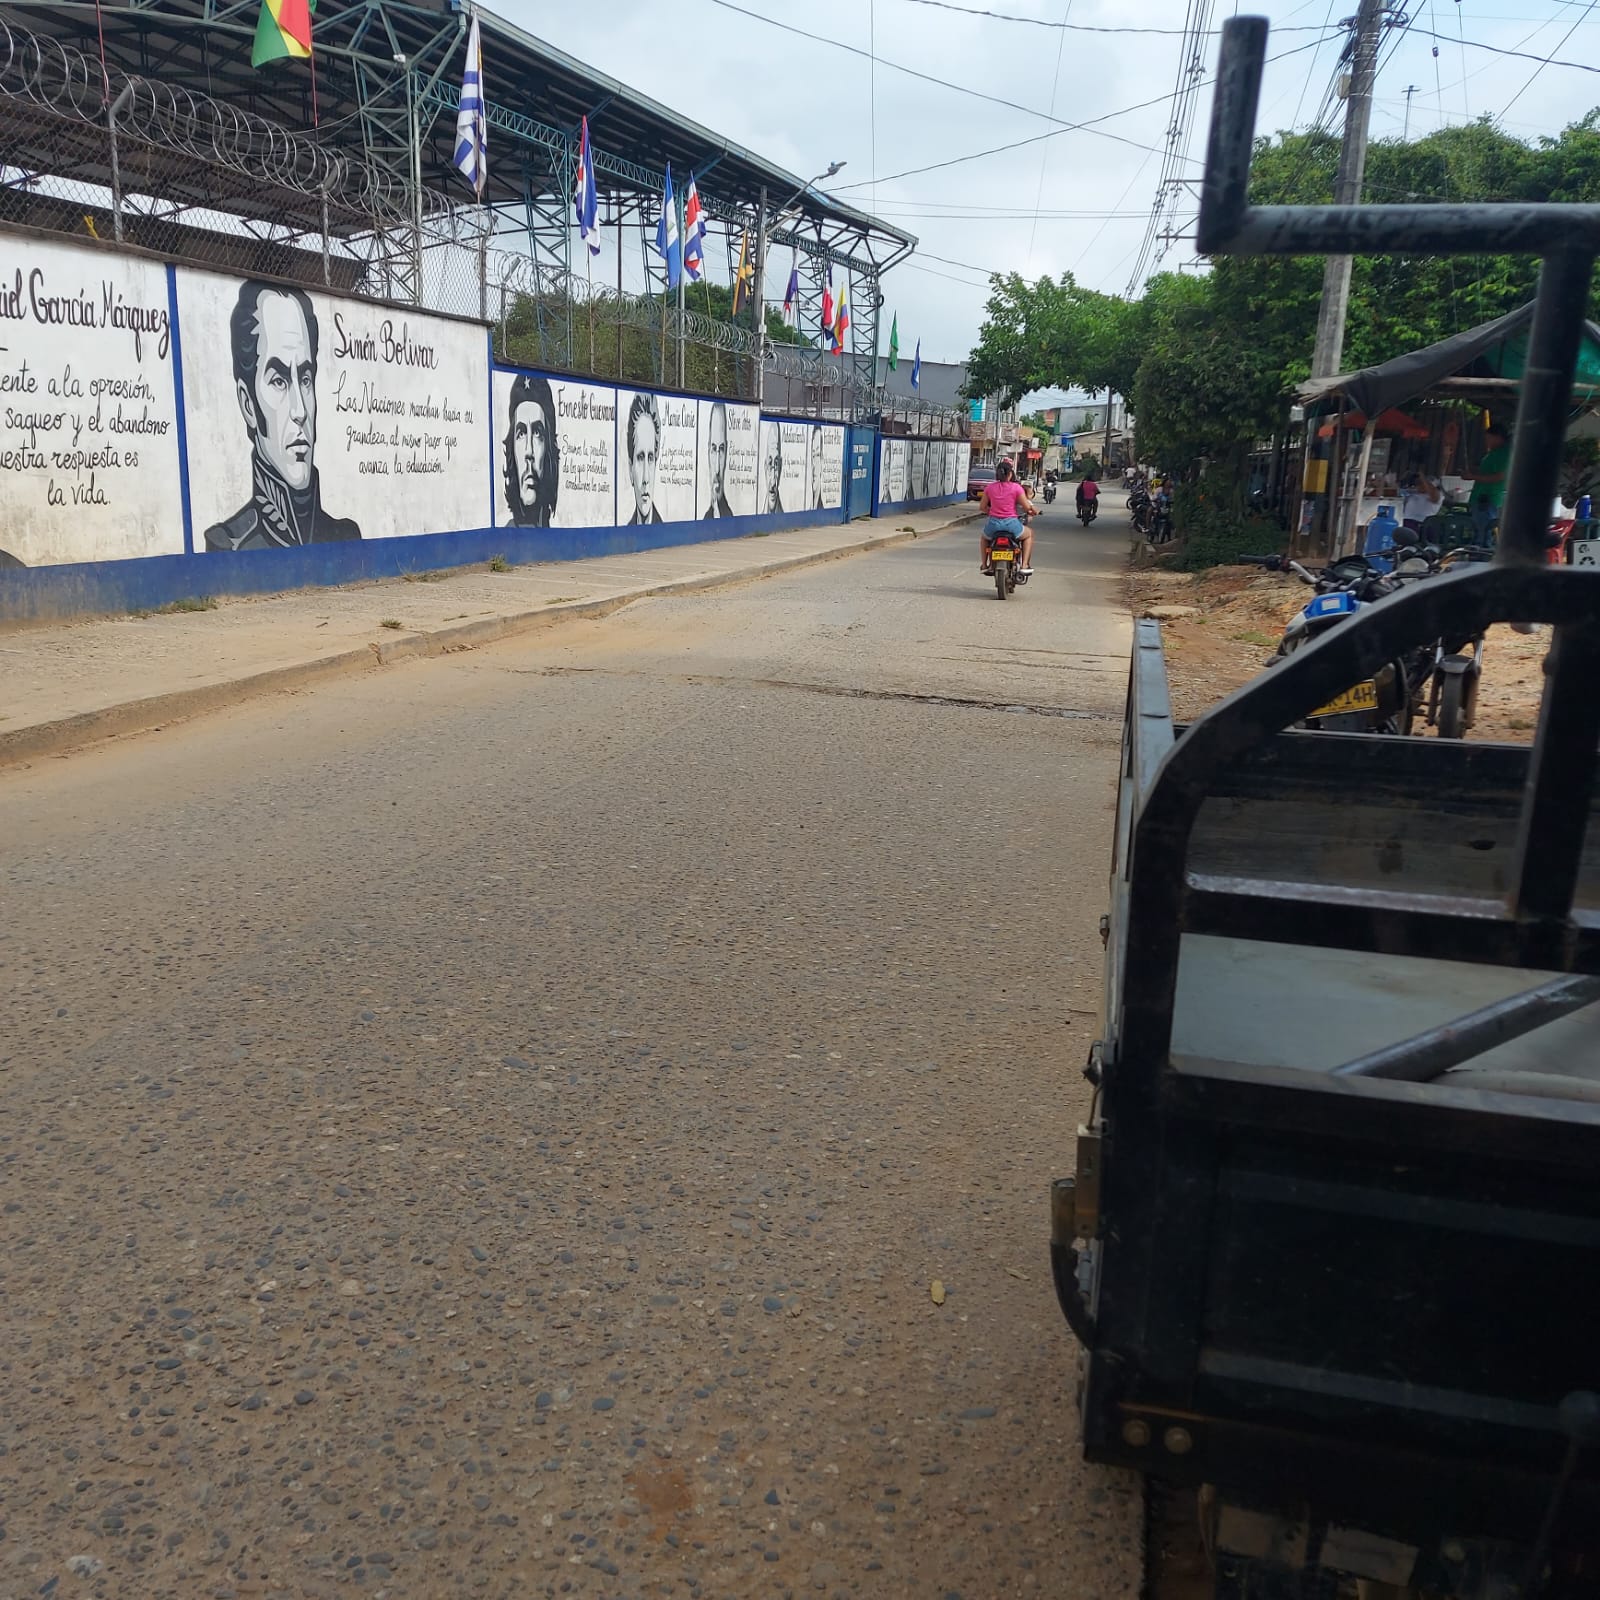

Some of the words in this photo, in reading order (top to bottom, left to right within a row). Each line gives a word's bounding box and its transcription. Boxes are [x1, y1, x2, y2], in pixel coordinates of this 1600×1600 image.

[29, 267, 98, 329] García
[100, 280, 171, 363] Márquez
[334, 312, 378, 362] Simón
[90, 372, 156, 403] opresión,
[332, 370, 357, 412] Las
[358, 381, 405, 416] Naciones
[409, 395, 440, 419] marchan
[558, 384, 589, 420] Ernesto
[71, 413, 83, 447] y
[88, 405, 104, 433] el
[109, 404, 171, 435] abandono
[346, 421, 388, 452] grandeza,
[390, 424, 399, 446] al
[444, 434, 458, 461] que
[50, 441, 121, 480] respuesta
[125, 450, 139, 467] es
[358, 460, 389, 475] avanza
[394, 453, 404, 475] la
[48, 478, 66, 506] la
[71, 472, 111, 506] vida.
